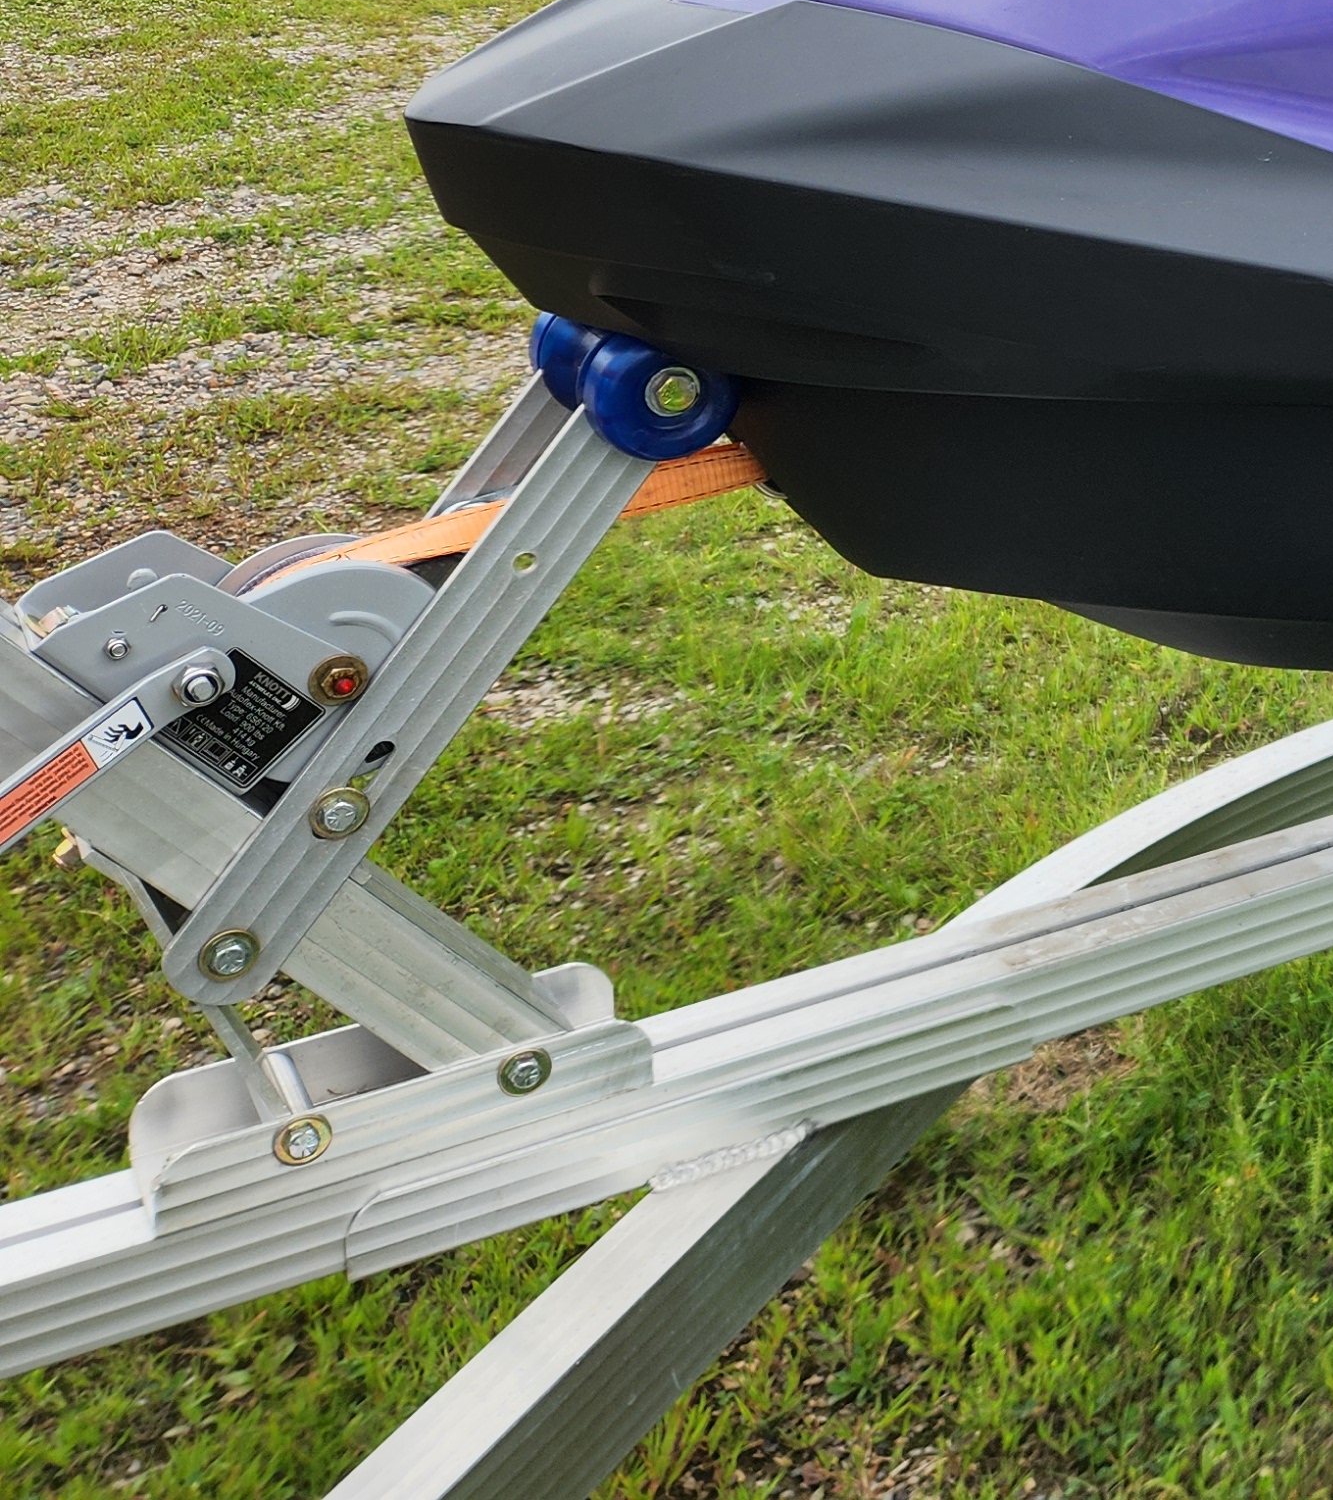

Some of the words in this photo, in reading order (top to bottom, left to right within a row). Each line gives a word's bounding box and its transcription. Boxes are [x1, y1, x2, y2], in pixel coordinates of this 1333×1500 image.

[253, 670, 291, 701] KNOTT
[244, 735, 256, 747] kg
[252, 728, 266, 741] lbs
[229, 736, 260, 762] Hungary
